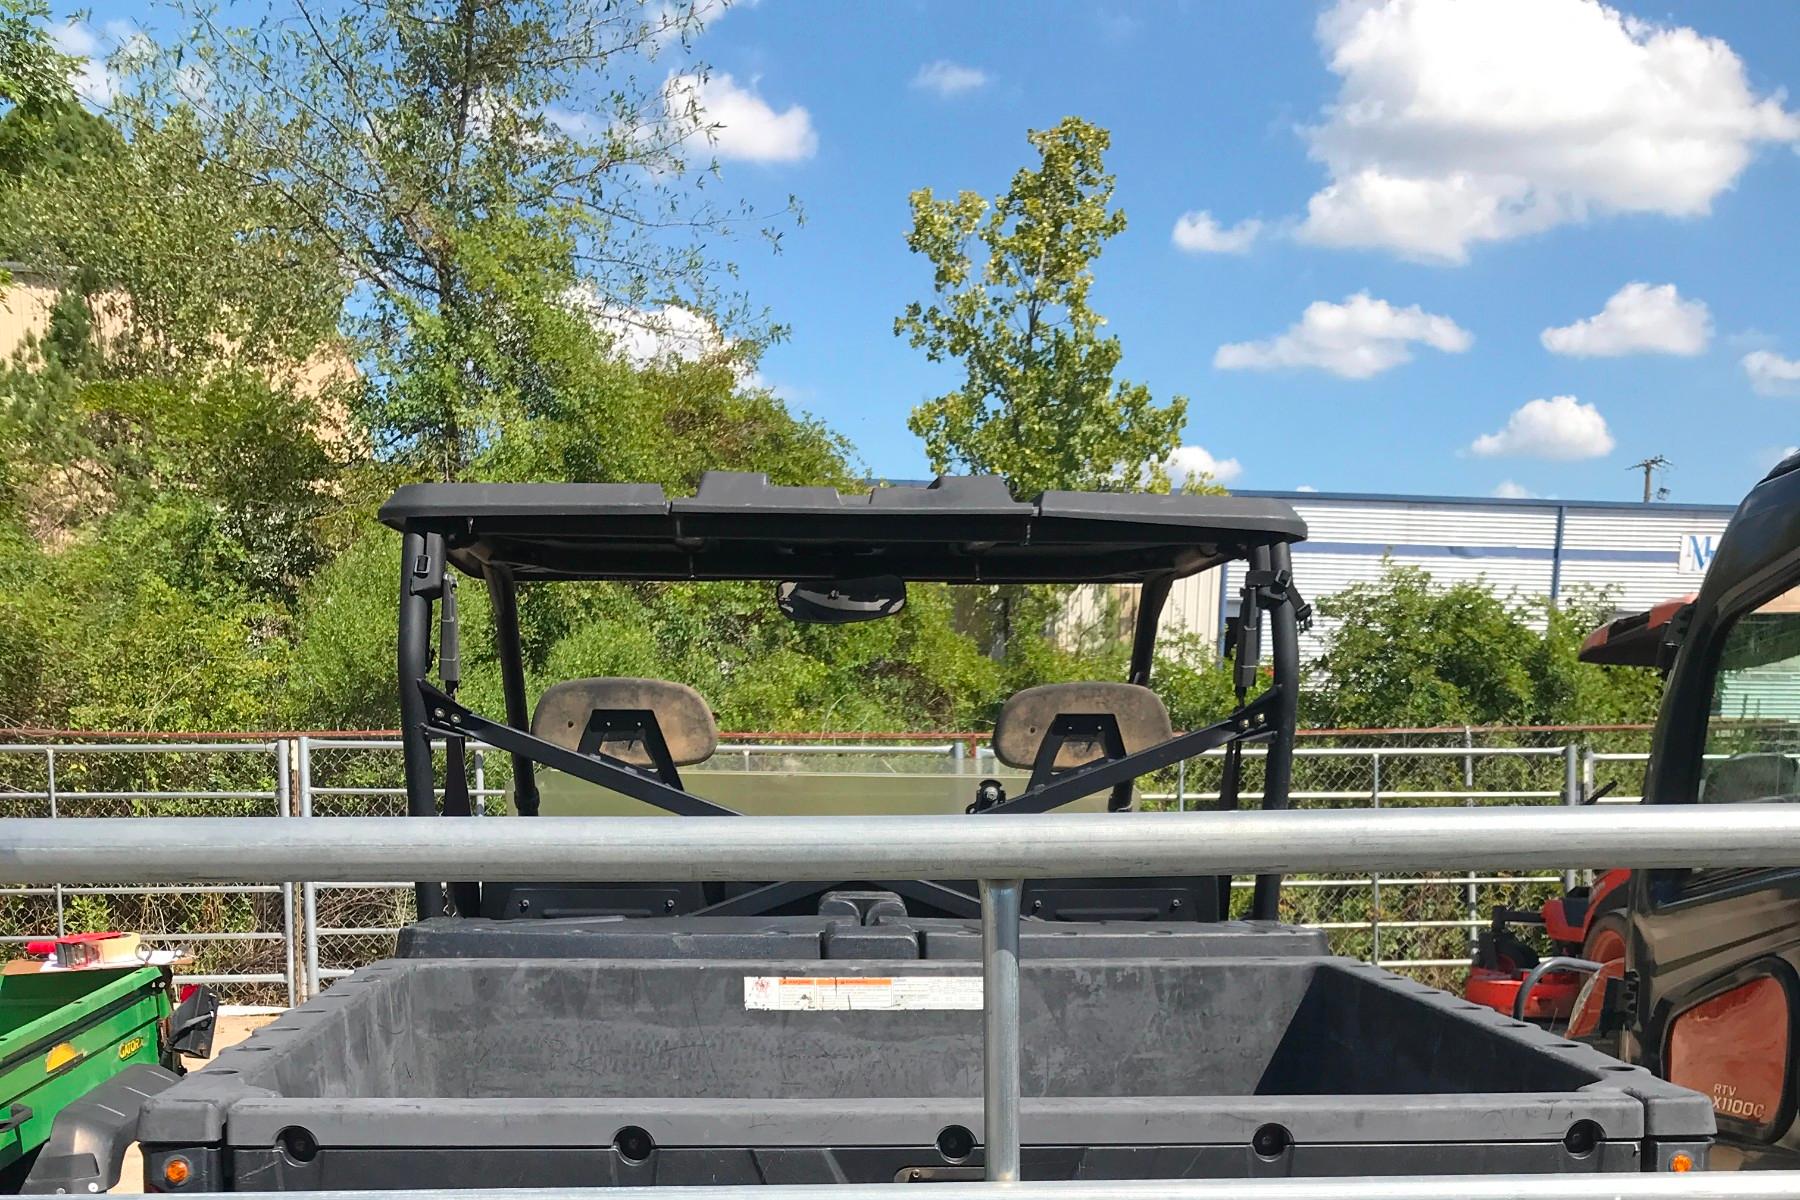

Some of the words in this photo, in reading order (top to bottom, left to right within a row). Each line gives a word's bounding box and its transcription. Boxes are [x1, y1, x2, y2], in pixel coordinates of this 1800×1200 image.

[118, 1037, 142, 1059] GATOR
[1713, 1083, 1737, 1096] RTV
[1713, 1095, 1765, 1118] X1100C
